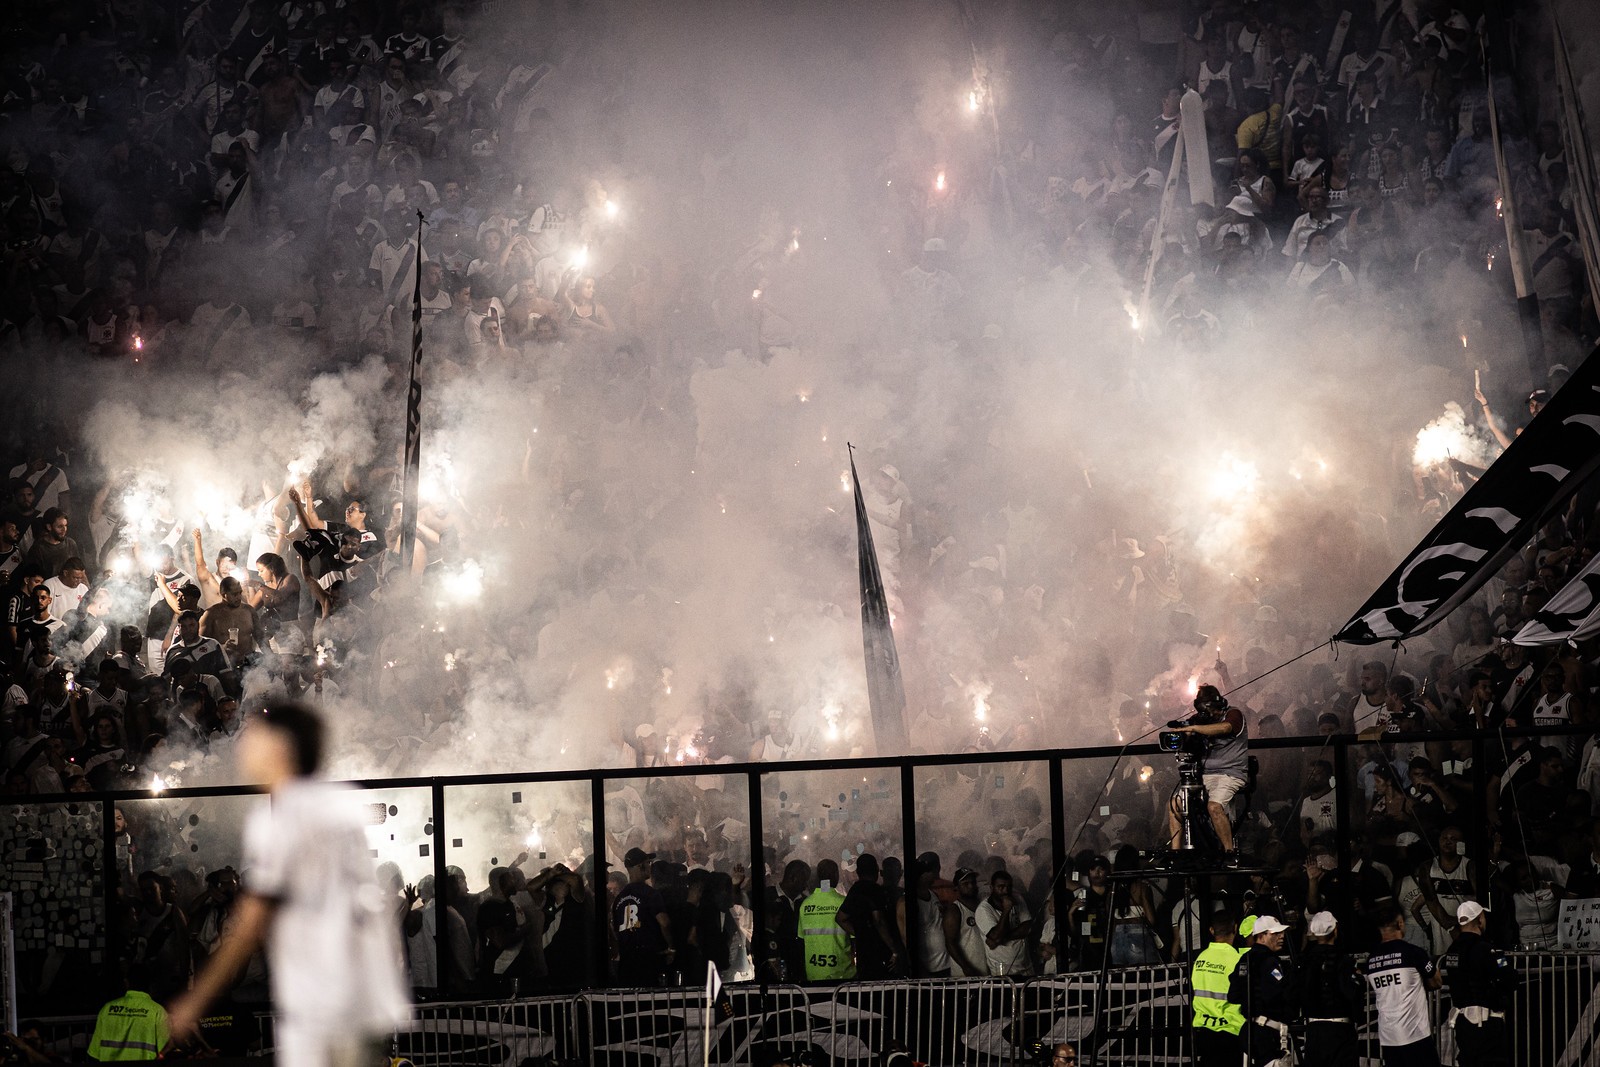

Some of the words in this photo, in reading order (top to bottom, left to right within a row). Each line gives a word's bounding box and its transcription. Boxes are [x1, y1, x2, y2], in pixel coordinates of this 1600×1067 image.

[810, 954, 837, 967] 453
[1206, 961, 1226, 971] Security
[1374, 974, 1401, 988] BEPE
[125, 1006, 149, 1014] Security
